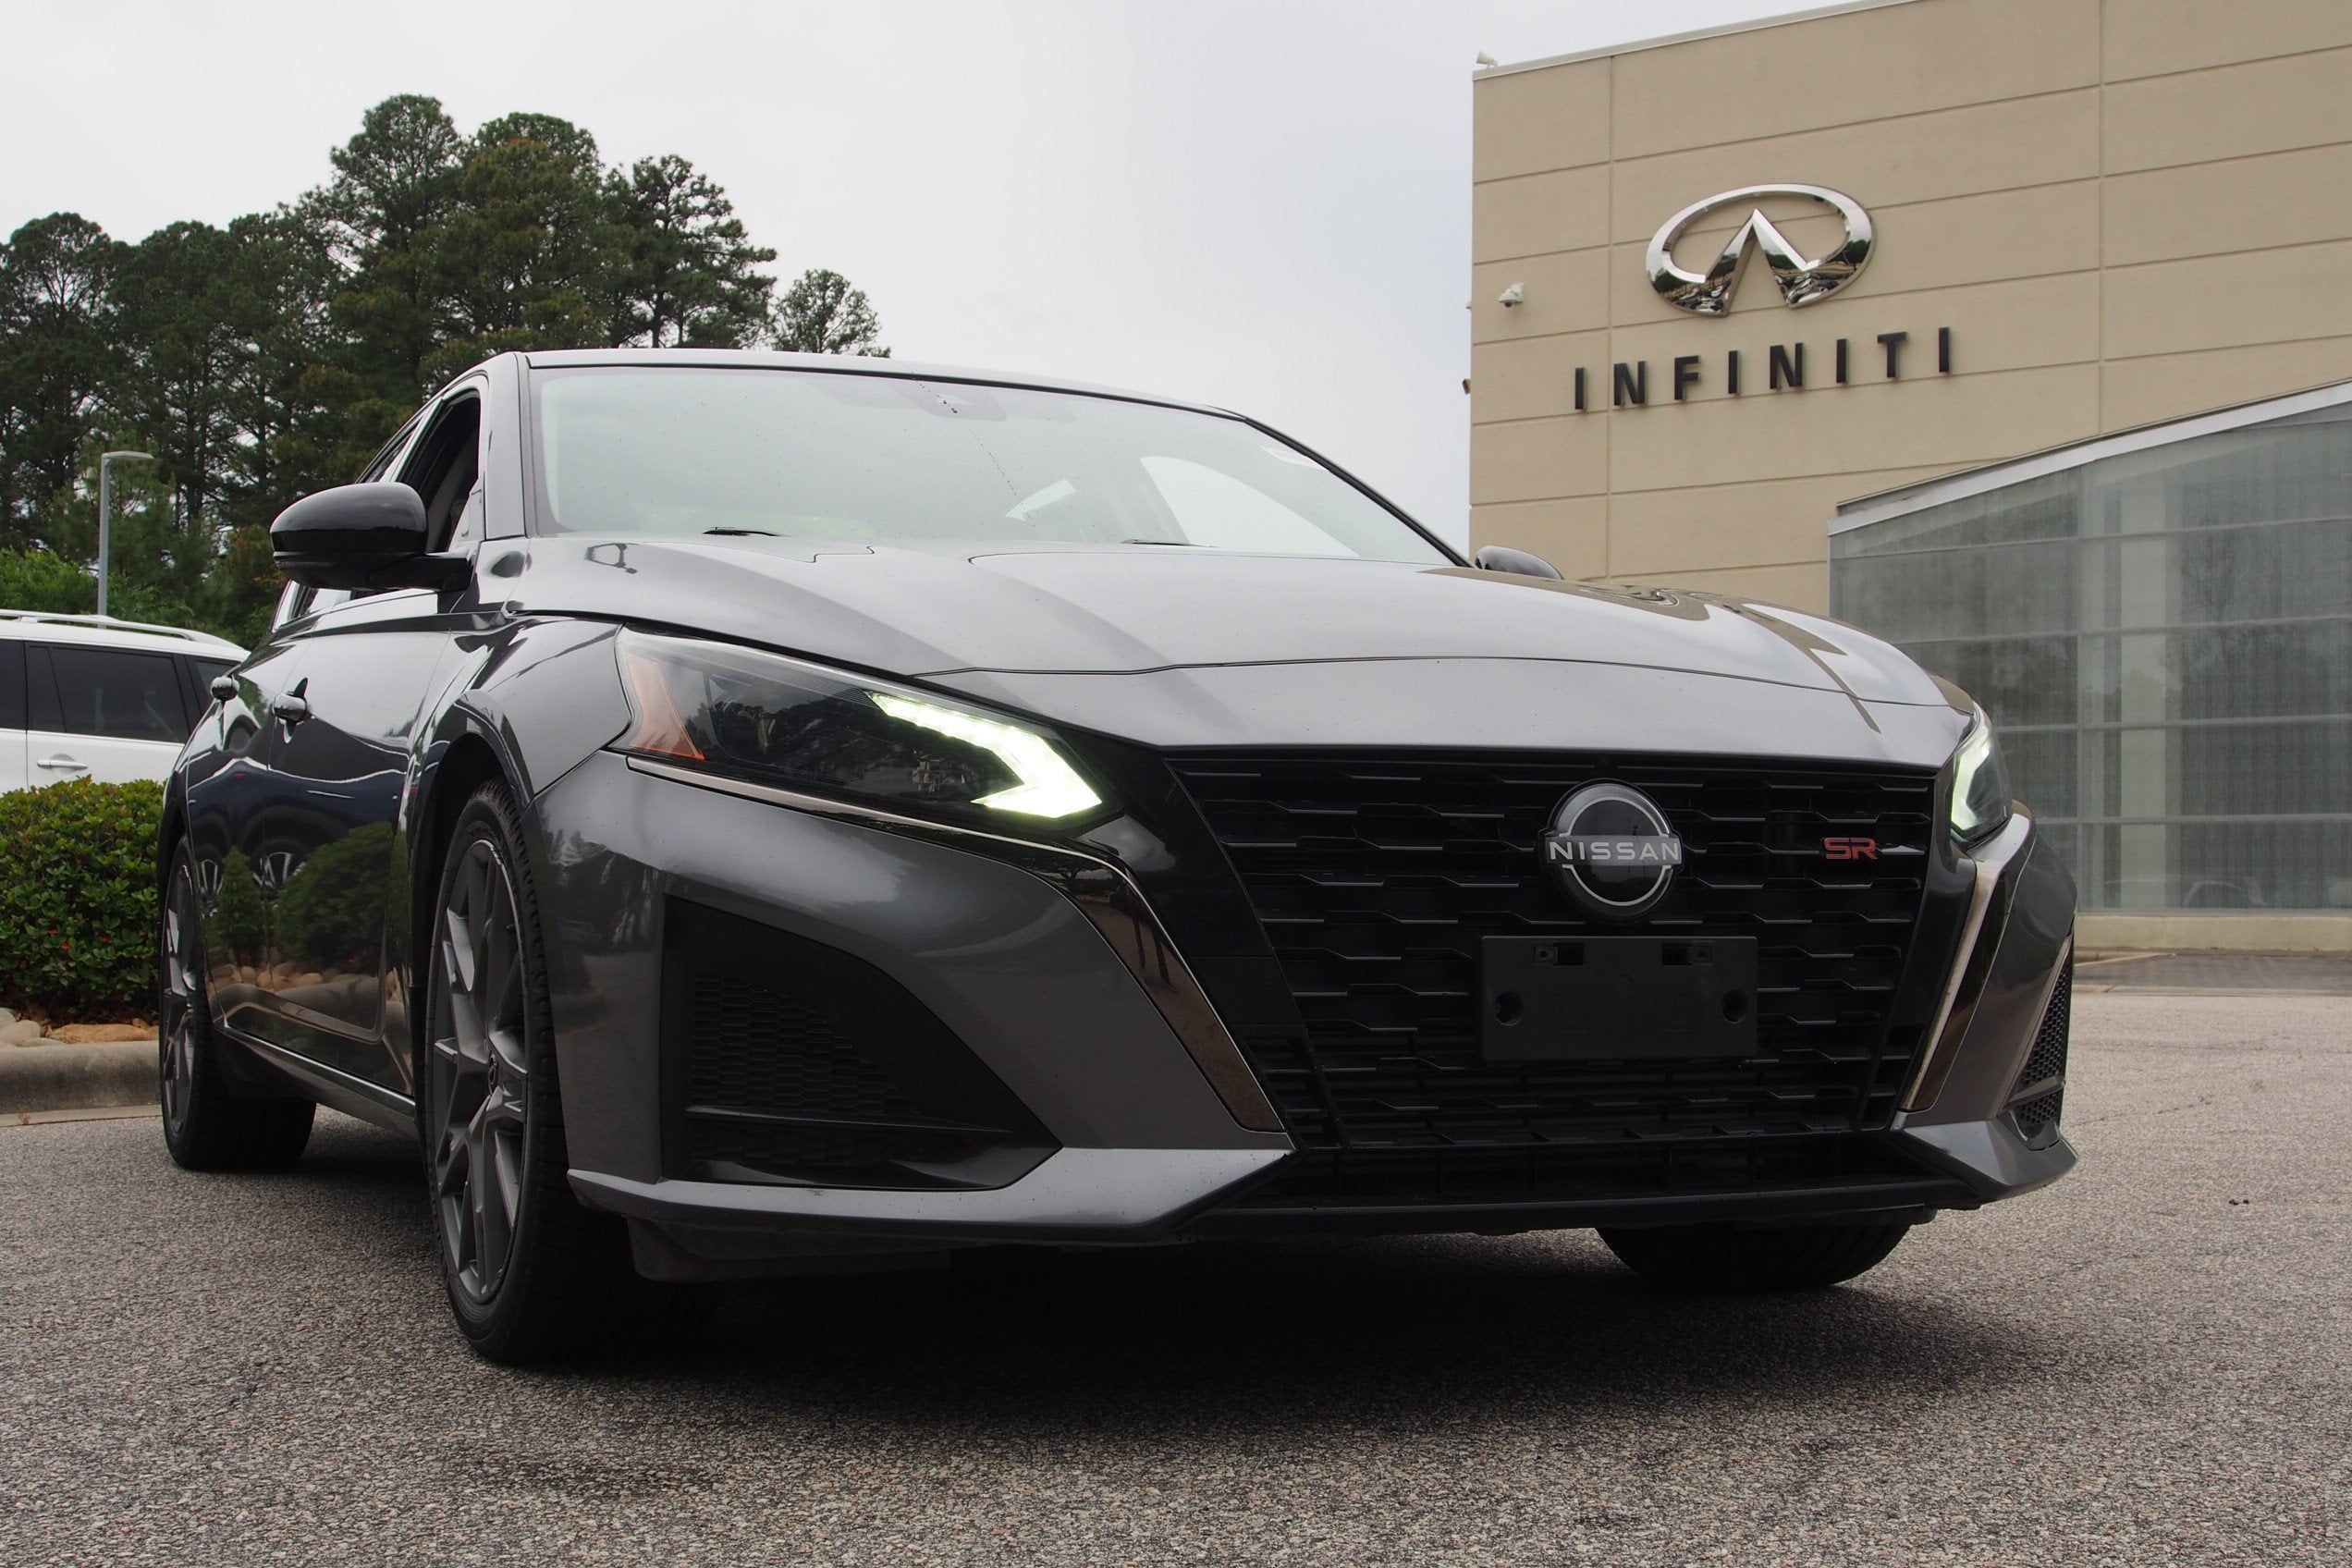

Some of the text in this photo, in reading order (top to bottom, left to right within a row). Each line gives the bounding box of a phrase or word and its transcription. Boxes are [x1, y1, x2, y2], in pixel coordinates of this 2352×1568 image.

[1574, 326, 1952, 410] INFINITI
[1550, 841, 1680, 861] NISSAN
[1824, 837, 1878, 860] SR
